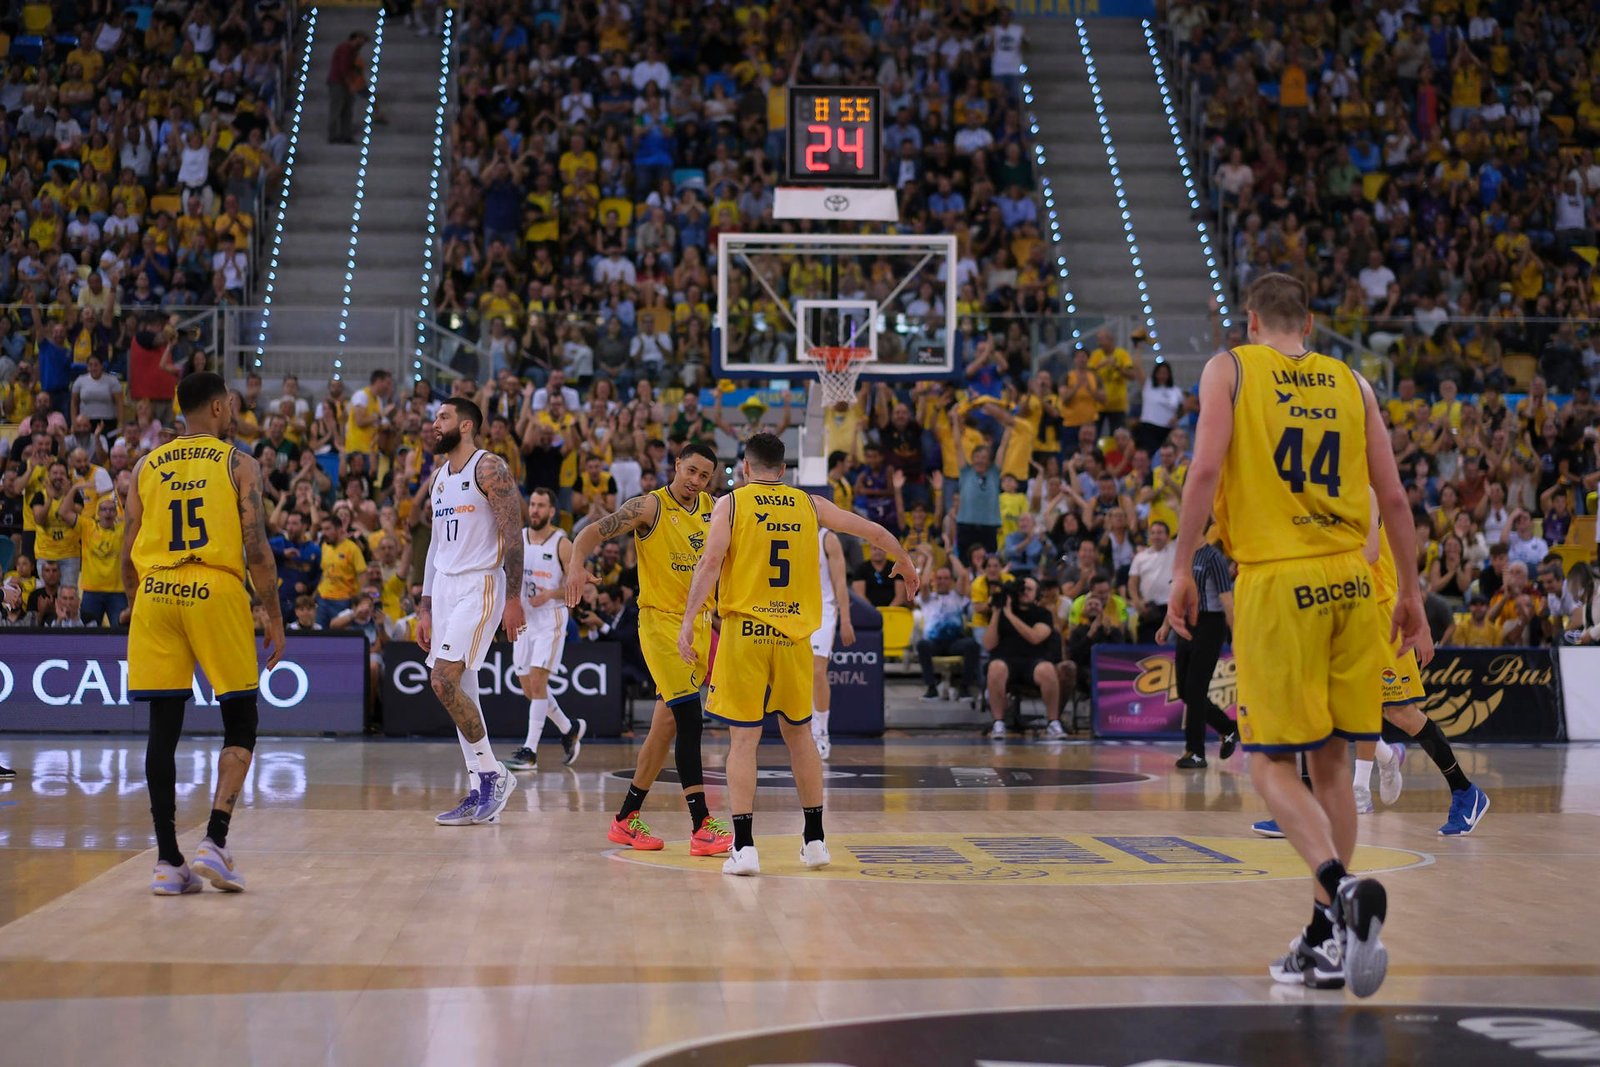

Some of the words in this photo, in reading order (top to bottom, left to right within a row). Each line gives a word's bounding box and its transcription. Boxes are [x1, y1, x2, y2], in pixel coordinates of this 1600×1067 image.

[814, 97, 829, 122] 8
[839, 97, 870, 122] 55
[805, 125, 864, 172] 24
[149, 447, 224, 470] LANDESBERG
[1273, 427, 1341, 498] 44
[754, 495, 796, 507] BASSAS
[168, 497, 209, 552] 15
[446, 519, 459, 542] 17
[768, 540, 790, 587] 5
[144, 576, 210, 600] Barceló
[1293, 575, 1370, 610] Baceló
[741, 620, 789, 638] Barc
[1481, 653, 1553, 686] Bus
